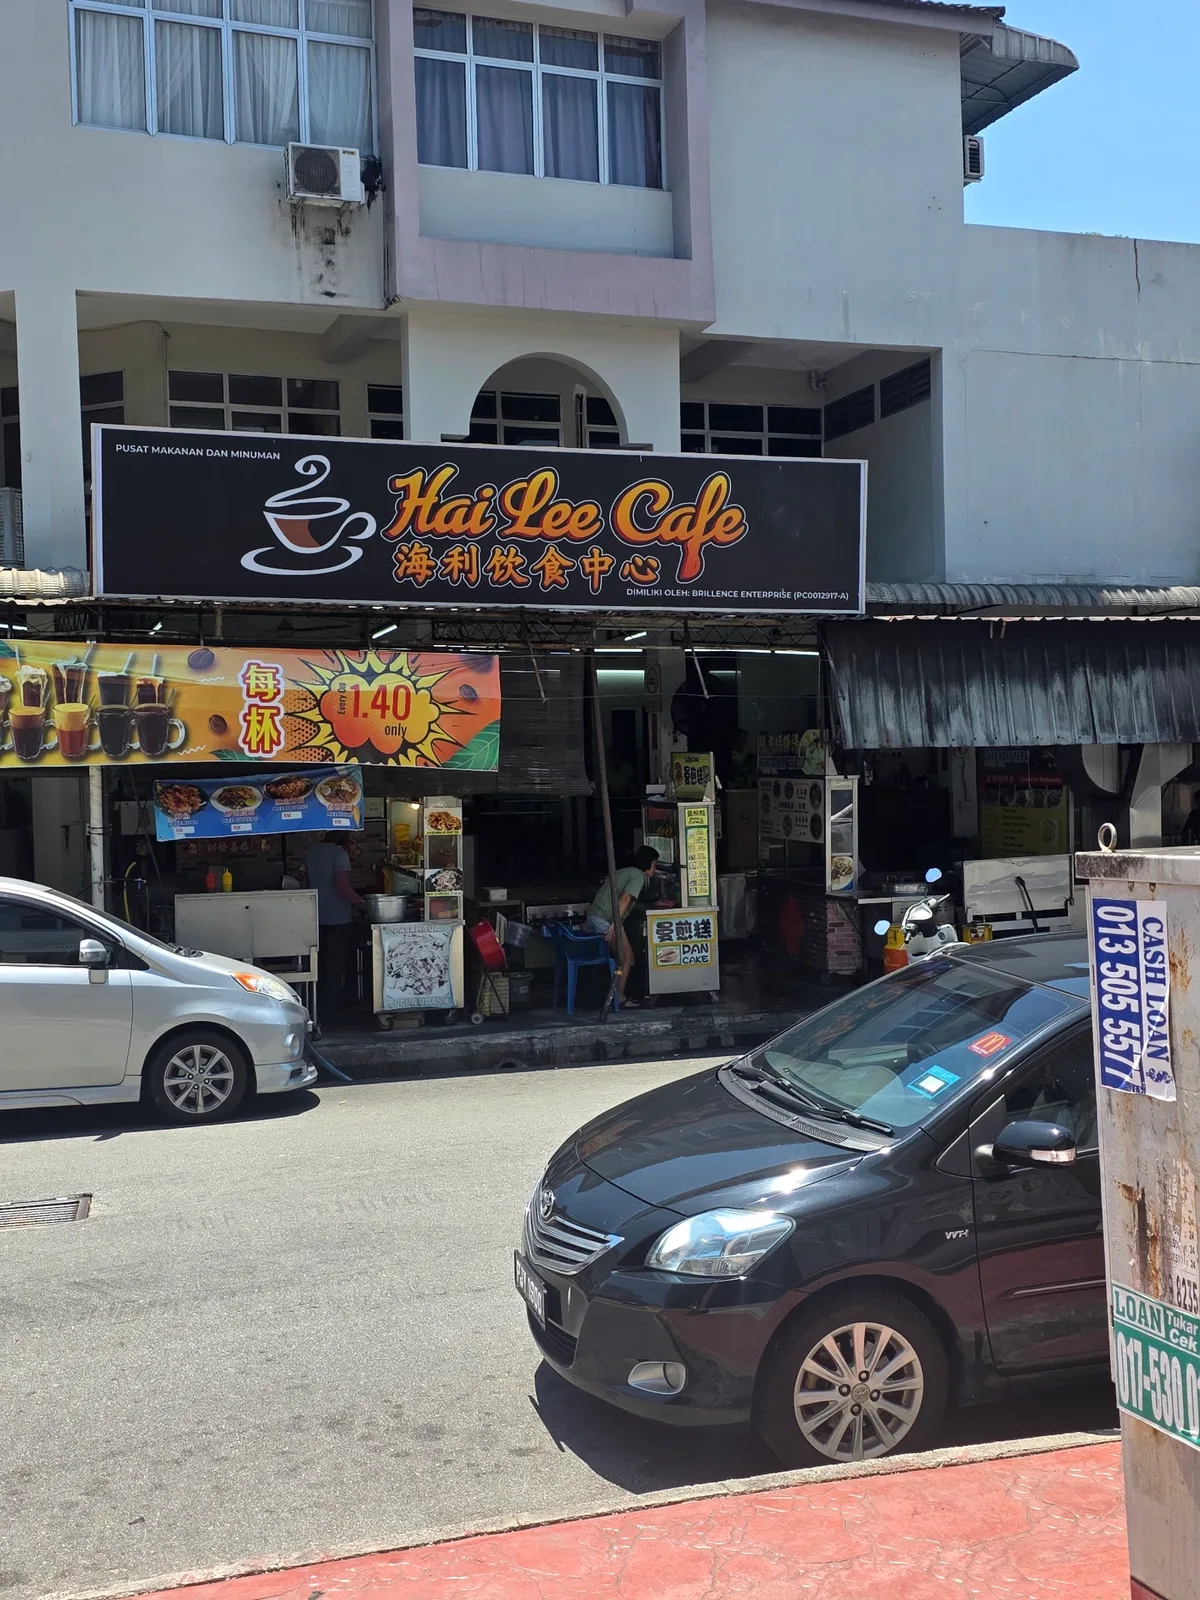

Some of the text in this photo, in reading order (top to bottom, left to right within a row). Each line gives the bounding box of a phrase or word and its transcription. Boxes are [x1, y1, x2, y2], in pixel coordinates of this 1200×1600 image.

[115, 443, 281, 460] PUSAT MAKANAN DAN MINUMAN
[382, 464, 748, 583] Hai Lee Cafe
[393, 541, 660, 594] 海利饮食中心
[626, 588, 849, 601] DIMILIKI OLEH: BRILLENCE ENTERPRISE (PC0012917-A)
[243, 661, 283, 754] 每杯
[337, 695, 347, 715] Every
[350, 684, 412, 721] 1.40
[384, 723, 408, 739] only
[1096, 905, 1137, 955] 013
[682, 955, 709, 965] CAKE
[1099, 961, 1139, 1014] 505
[1142, 916, 1170, 1063] CASH LOAN
[1115, 1289, 1164, 1338] LOAN
[1166, 1309, 1199, 1335] Tukar
[1169, 1327, 1198, 1352] Cek
[1117, 1331, 1184, 1434] 017-530
